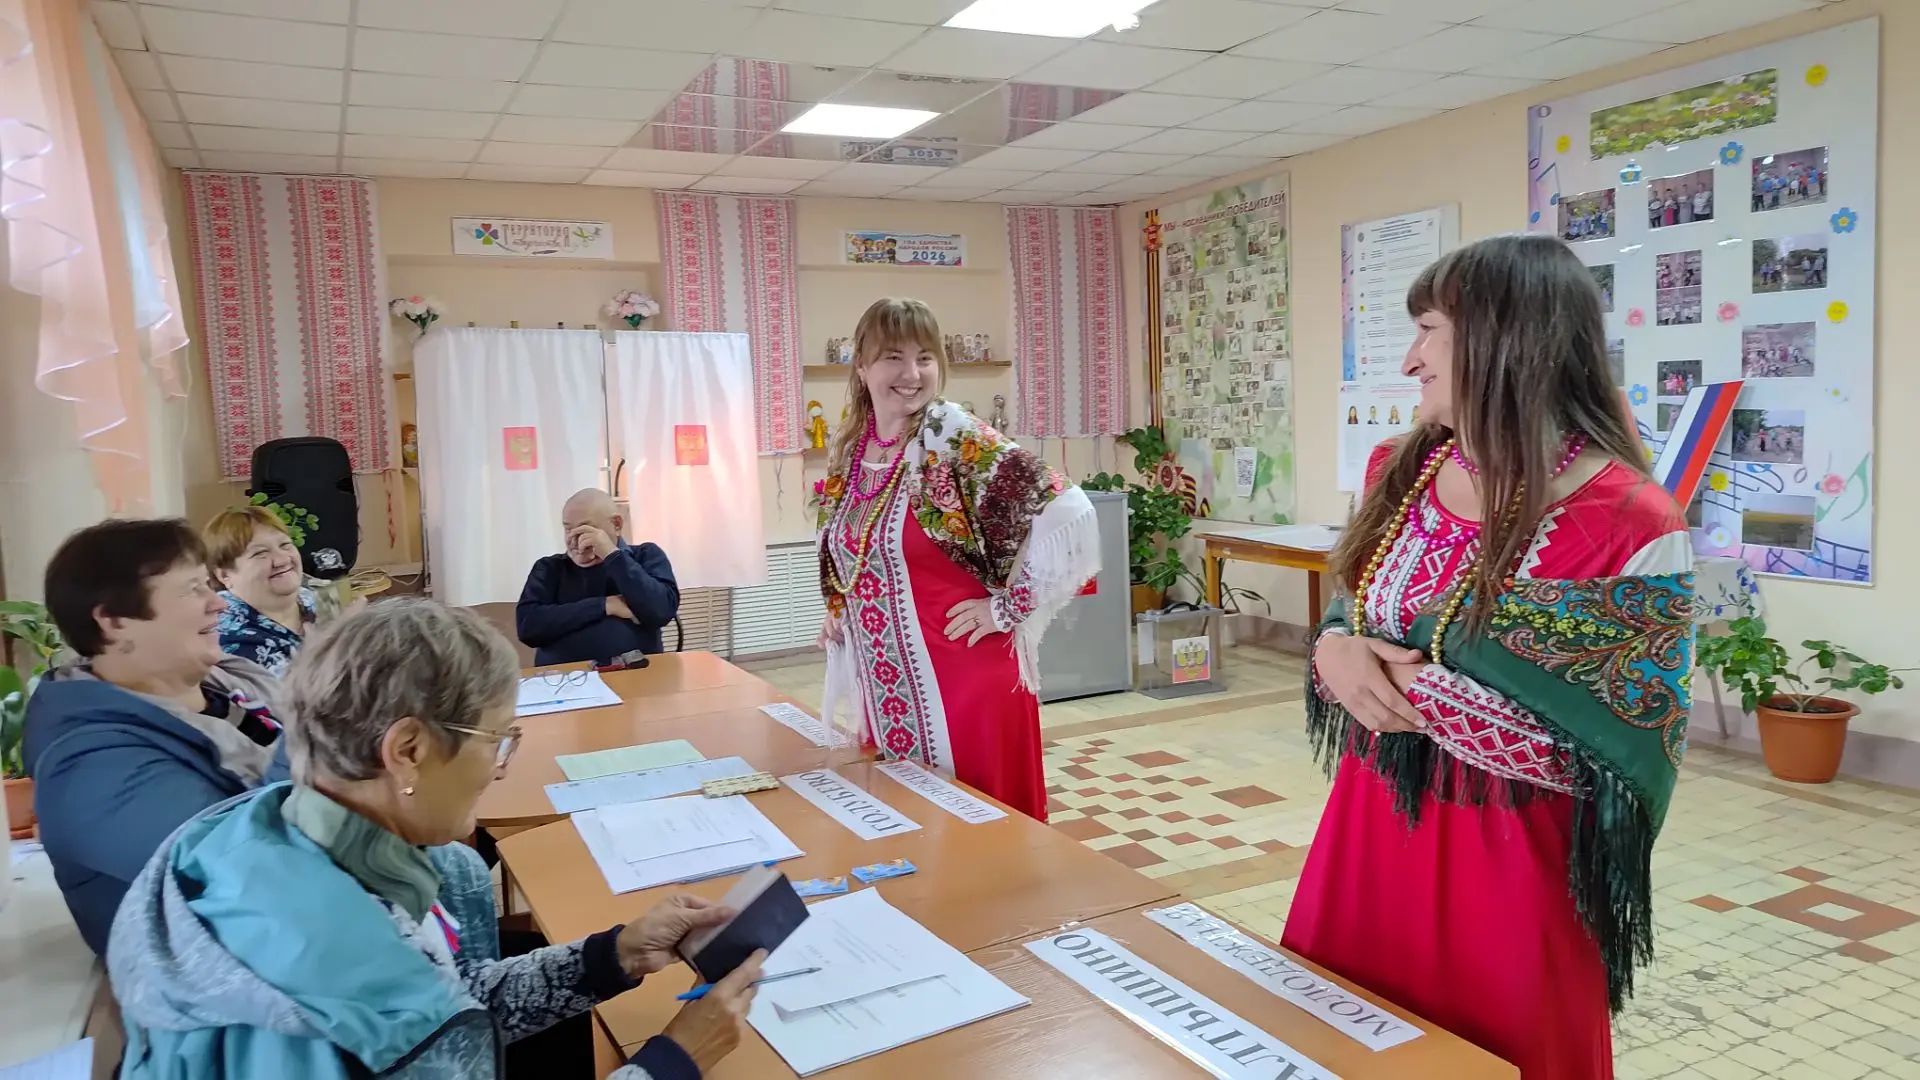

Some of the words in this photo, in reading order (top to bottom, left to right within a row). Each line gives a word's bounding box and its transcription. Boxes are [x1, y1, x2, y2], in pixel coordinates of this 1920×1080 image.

[1226, 190, 1286, 217] ПОБЕДИТЕЛЕЙ
[912, 250, 946, 260] 2026
[799, 771, 903, 832] ГОЛУБЕВО
[1165, 908, 1401, 1037] МОЛОДЕЖНАЯ
